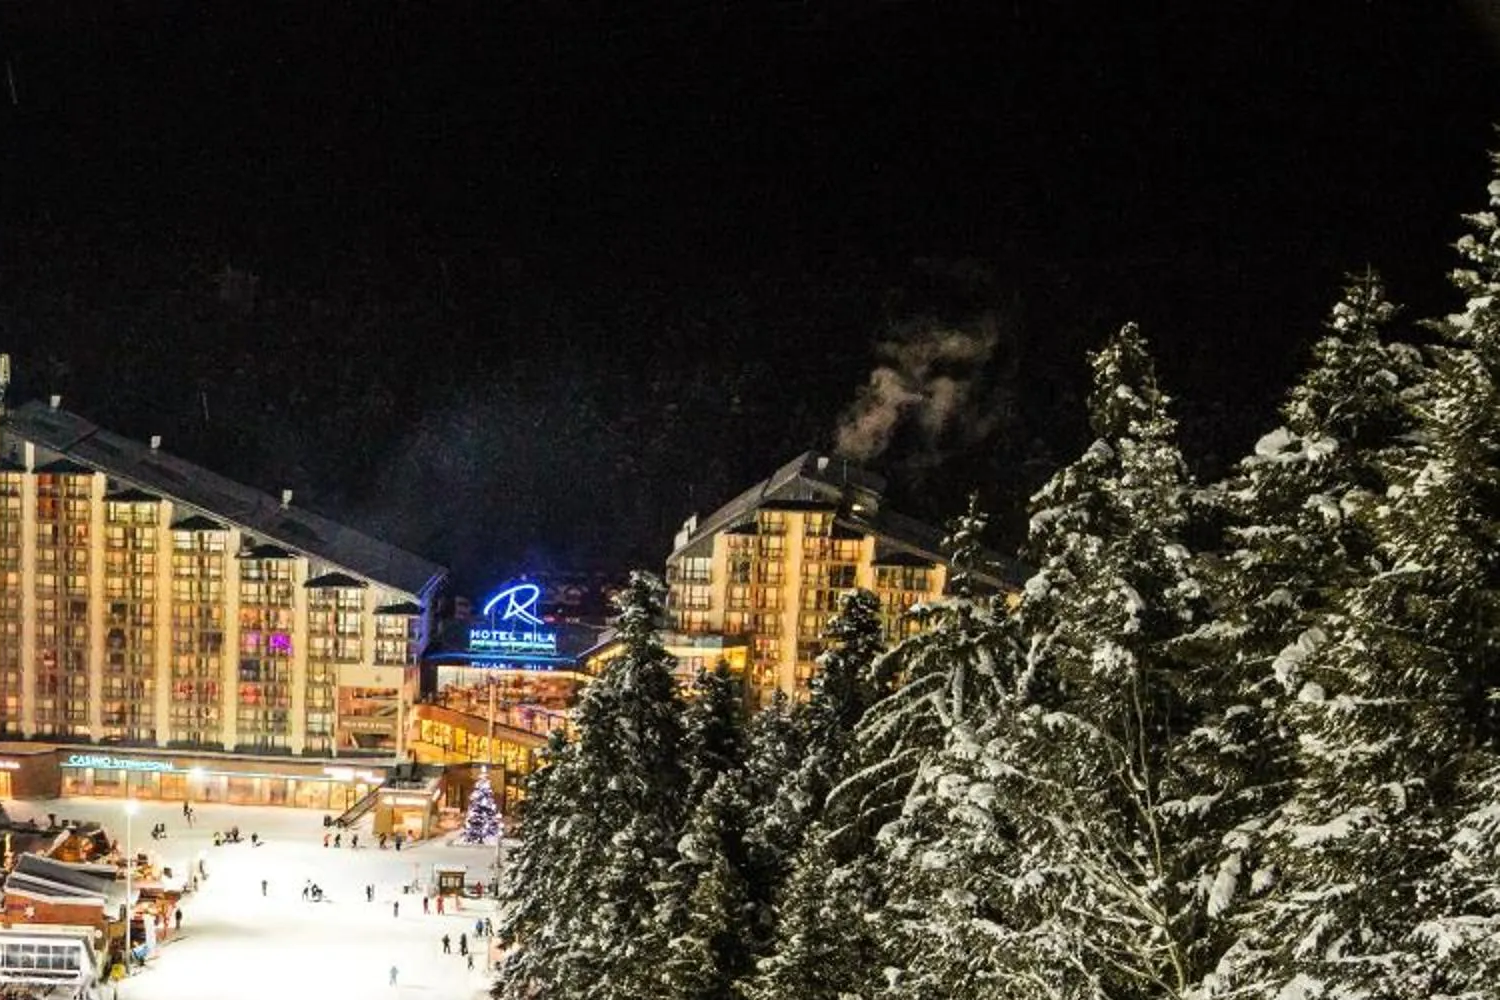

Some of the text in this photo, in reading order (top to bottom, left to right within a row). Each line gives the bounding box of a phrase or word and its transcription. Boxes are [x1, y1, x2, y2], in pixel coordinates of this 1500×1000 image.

[470, 629, 556, 643] HOTEL RILA
[67, 755, 111, 768] CASINO
